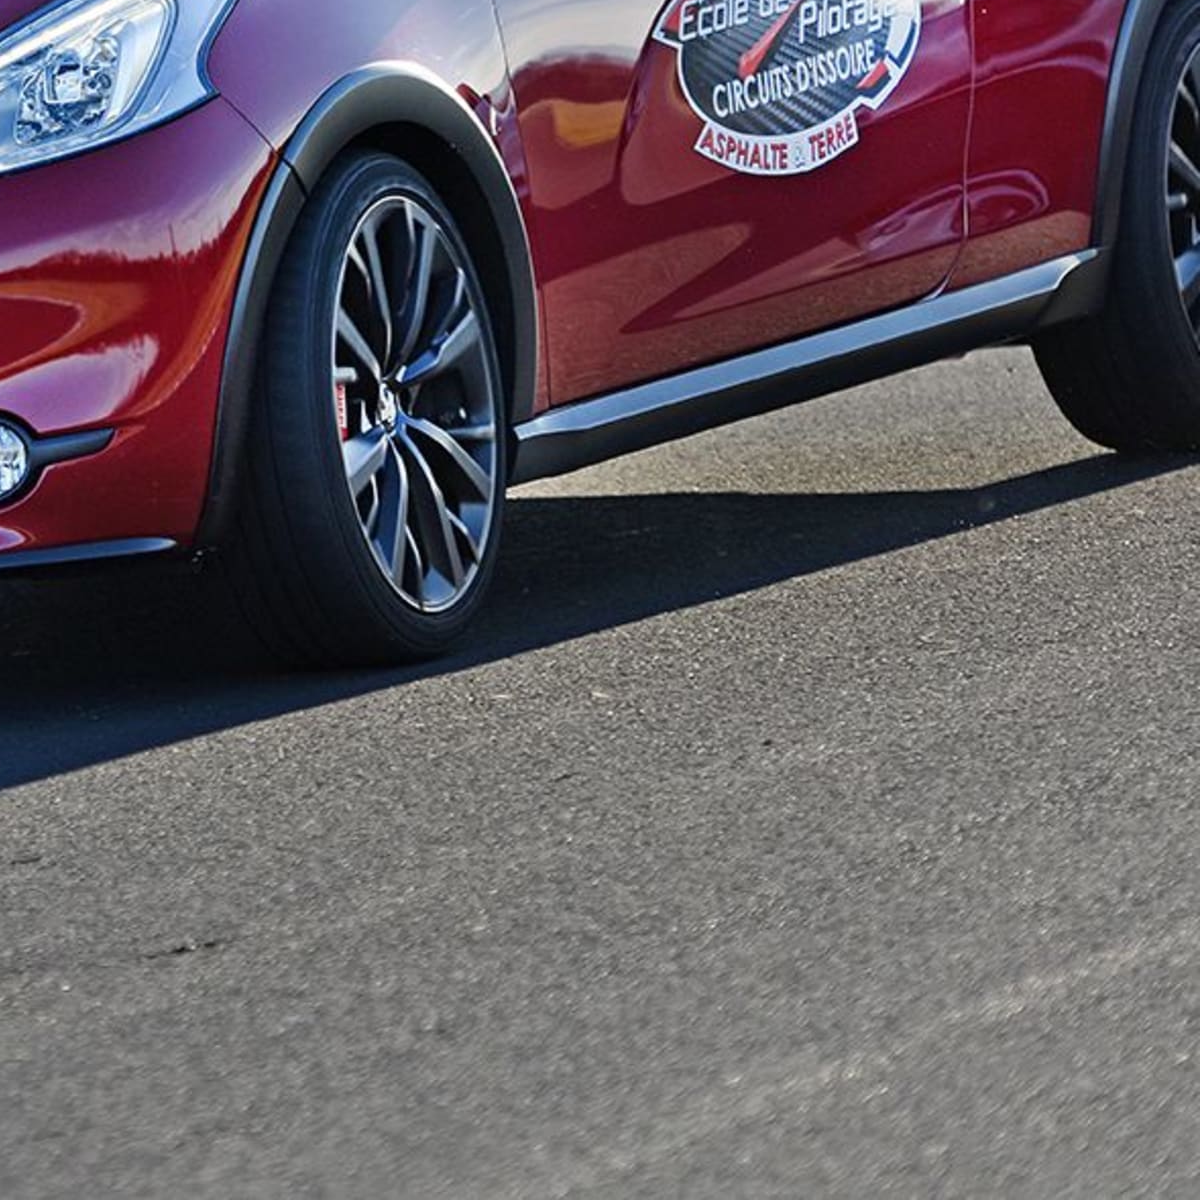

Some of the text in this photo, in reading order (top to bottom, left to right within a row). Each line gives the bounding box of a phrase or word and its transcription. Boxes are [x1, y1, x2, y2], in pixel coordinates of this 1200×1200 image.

[712, 39, 875, 118] CIRCUITS D'ISSOIRE
[700, 127, 788, 170] ASPHALTE
[808, 112, 854, 162] TERRE
